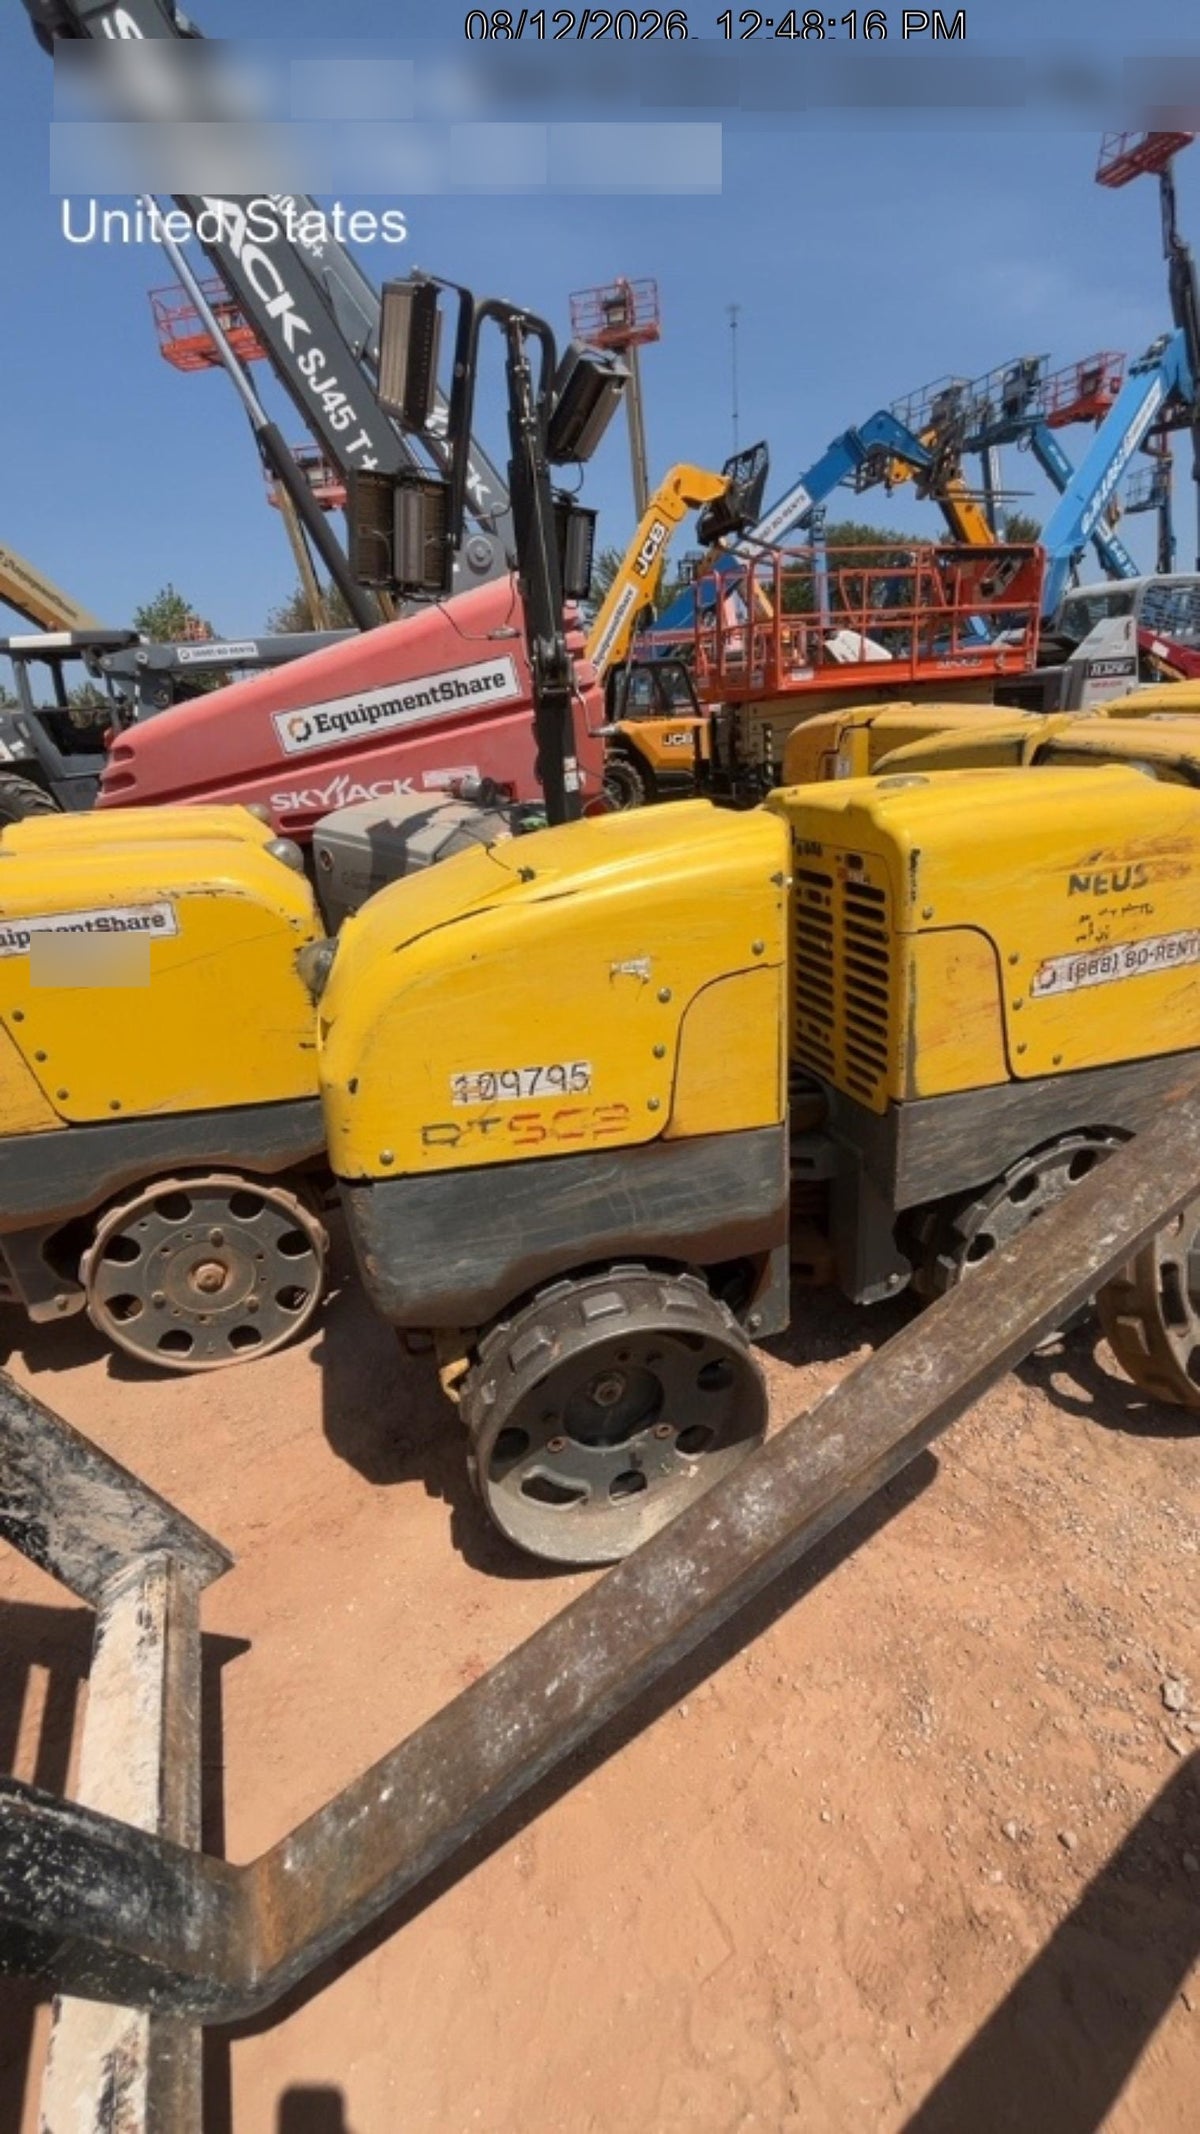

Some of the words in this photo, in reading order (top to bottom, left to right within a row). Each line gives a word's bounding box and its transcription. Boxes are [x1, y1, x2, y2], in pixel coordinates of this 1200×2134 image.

[297, 348, 357, 431] SJ45
[636, 522, 666, 576] JCB
[313, 671, 507, 735] EquipmentShare
[663, 734, 693, 746] JCB
[269, 774, 416, 814] SKYJACK
[455, 1063, 590, 1103] 109795
